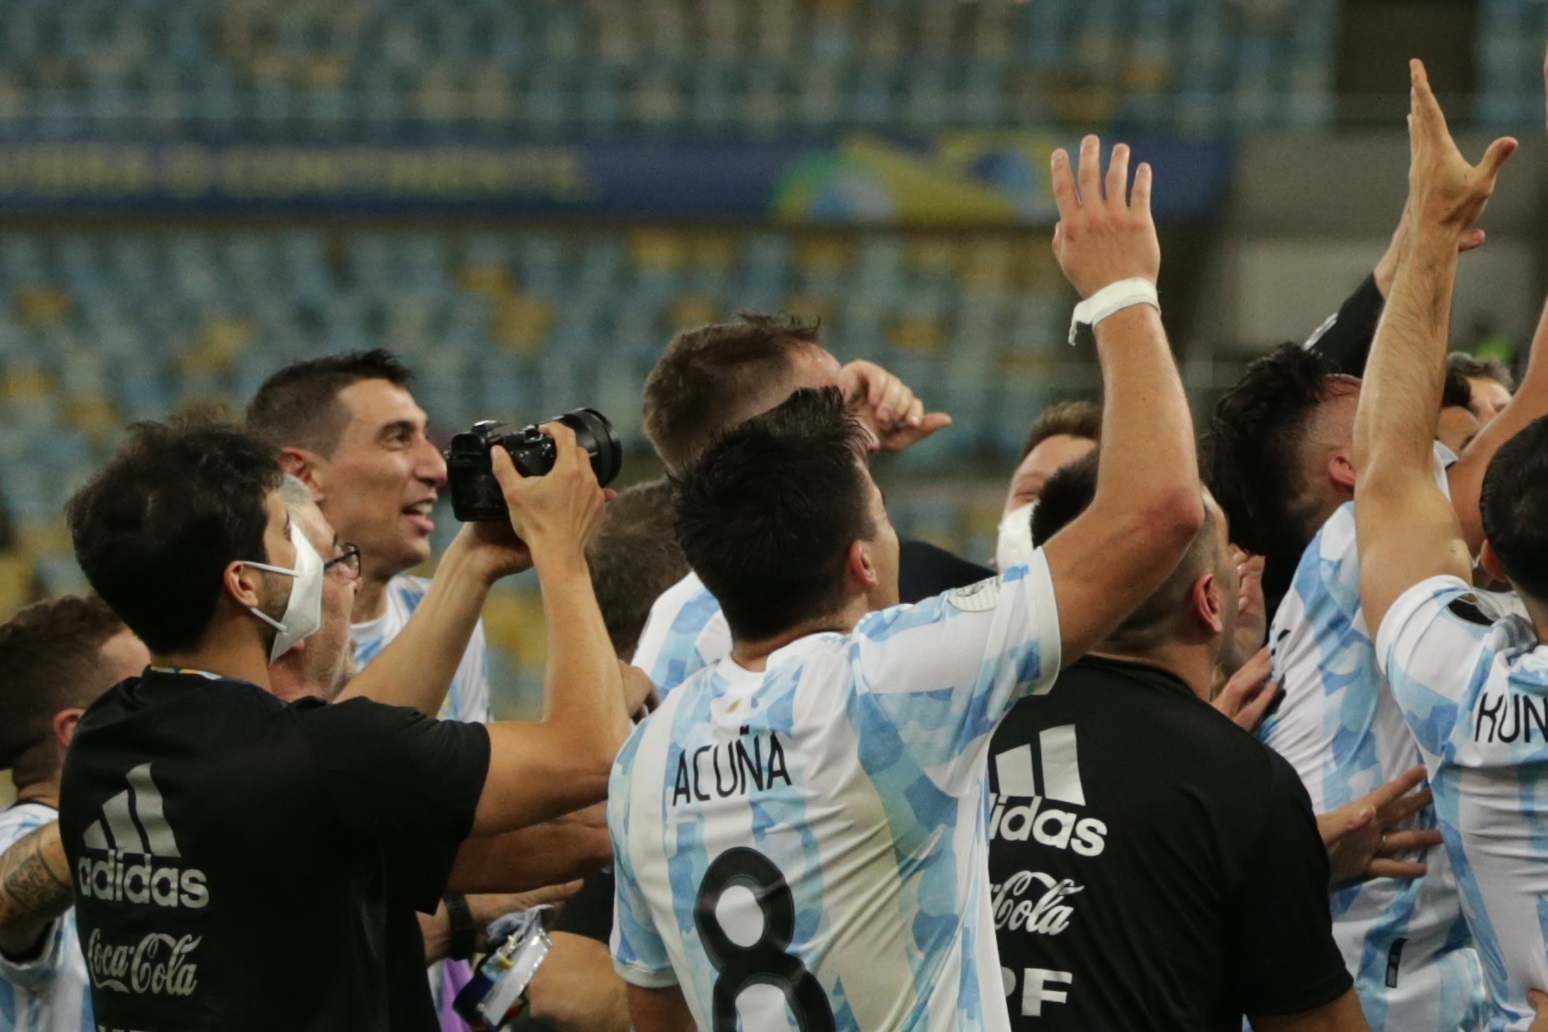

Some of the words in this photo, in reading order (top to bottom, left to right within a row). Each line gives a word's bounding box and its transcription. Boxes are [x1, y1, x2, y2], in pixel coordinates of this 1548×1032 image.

[672, 724, 793, 807] ACUÑA
[990, 794, 1108, 857] idas
[78, 849, 210, 909] adidas
[88, 928, 203, 997] Coca-Cola
[694, 846, 836, 1032] 8
